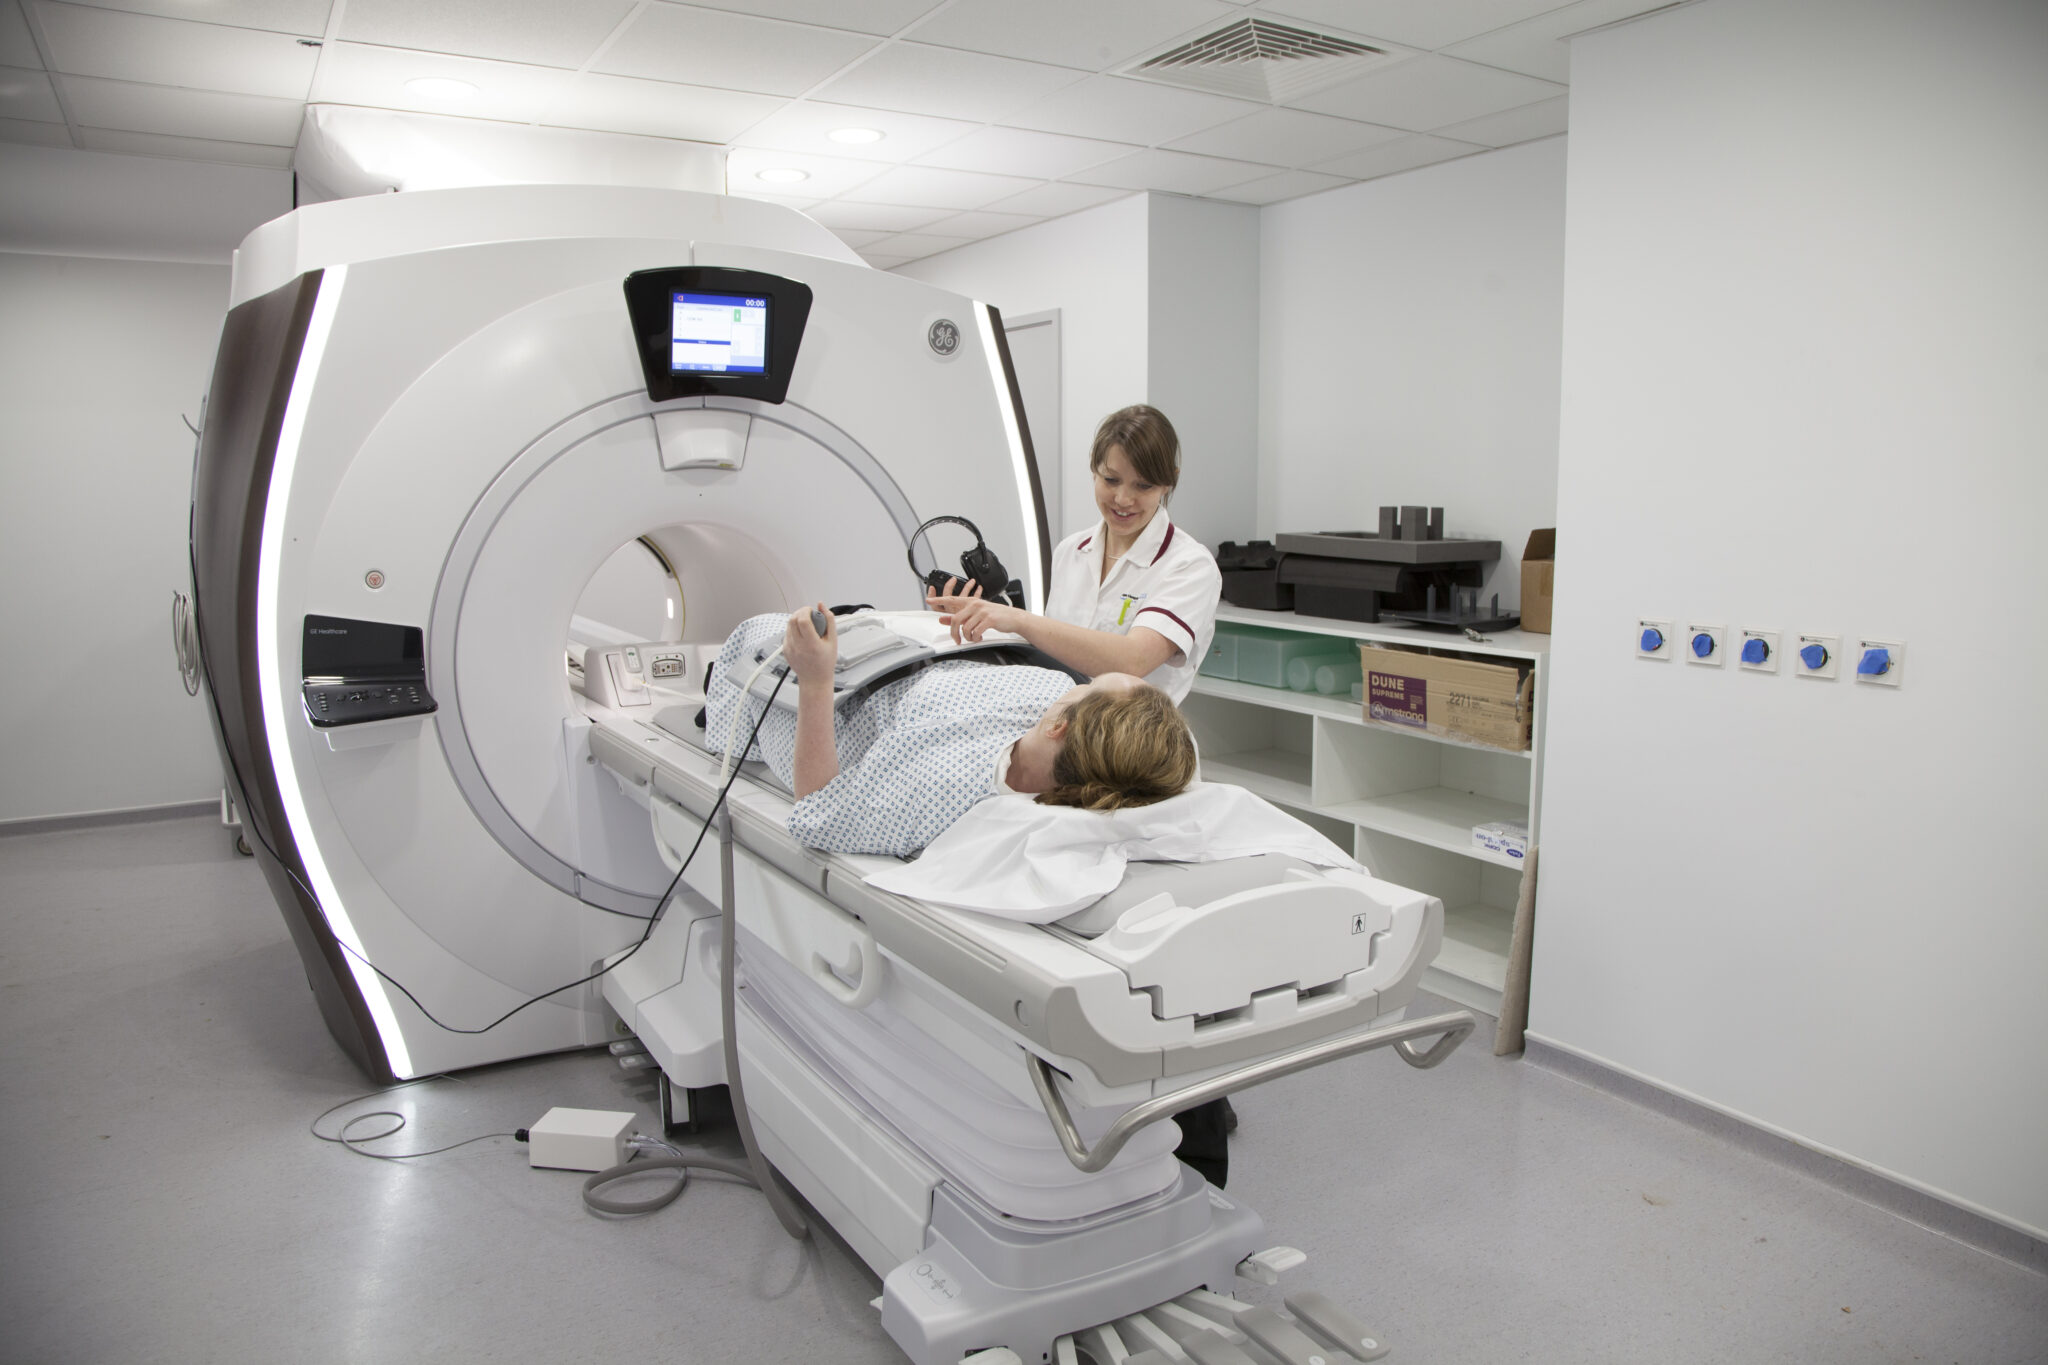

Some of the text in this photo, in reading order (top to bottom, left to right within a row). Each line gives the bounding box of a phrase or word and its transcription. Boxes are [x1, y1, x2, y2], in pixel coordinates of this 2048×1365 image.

[745, 298, 765, 308] 00:00
[1371, 674, 1405, 691] DUNE
[1372, 688, 1405, 700] SUPREME
[1449, 692, 1471, 708] 2271
[1372, 701, 1424, 725] Armstrong
